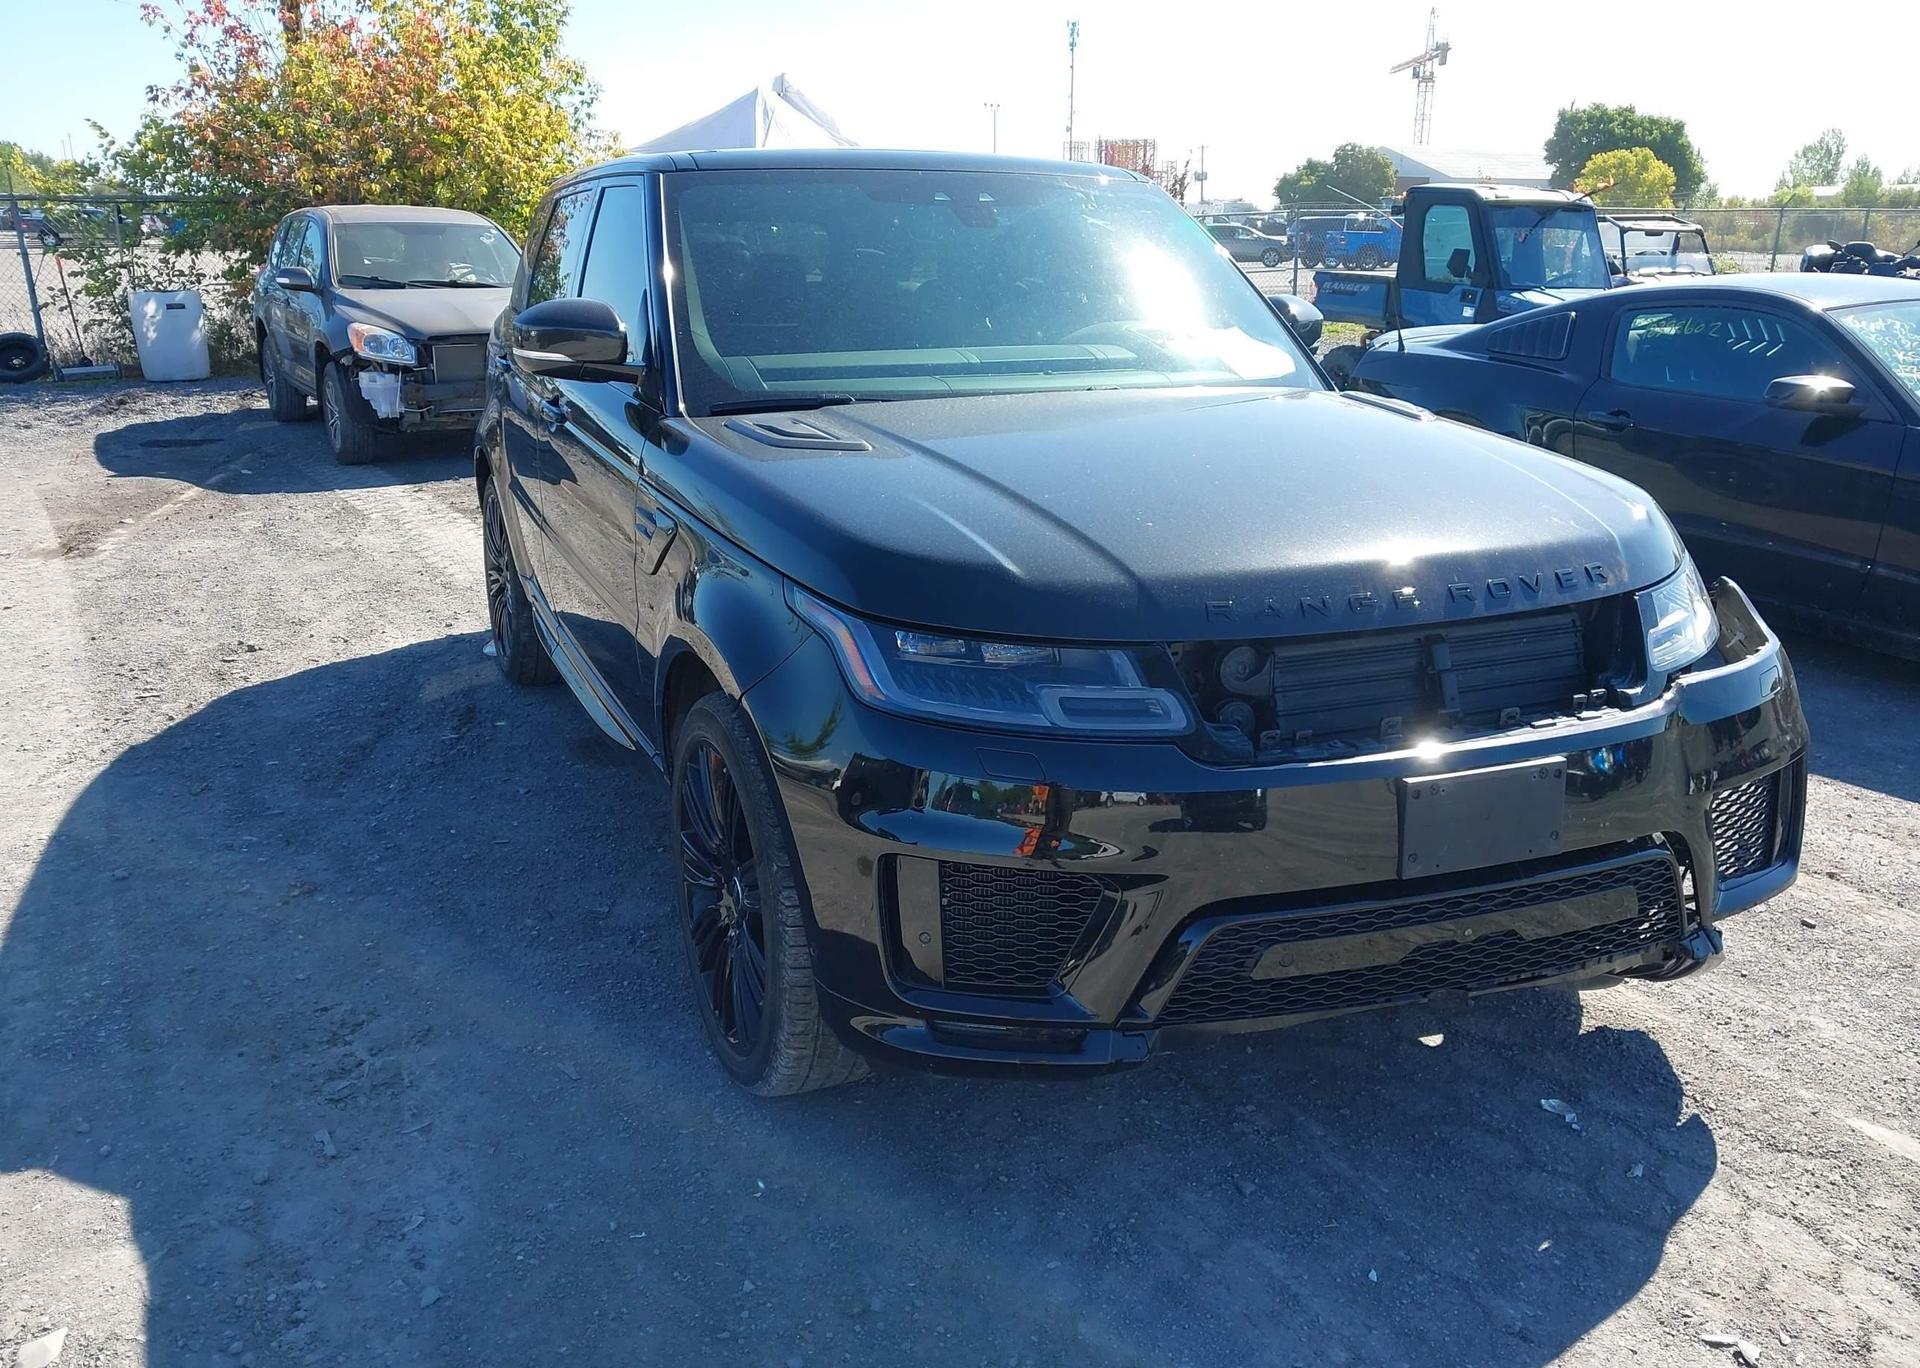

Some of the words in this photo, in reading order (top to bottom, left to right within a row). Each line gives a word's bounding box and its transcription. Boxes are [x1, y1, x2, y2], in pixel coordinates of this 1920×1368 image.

[1322, 281, 1370, 292] RANGER
[1203, 586, 1422, 623] RANGE
[1447, 561, 1609, 606] ROVER
